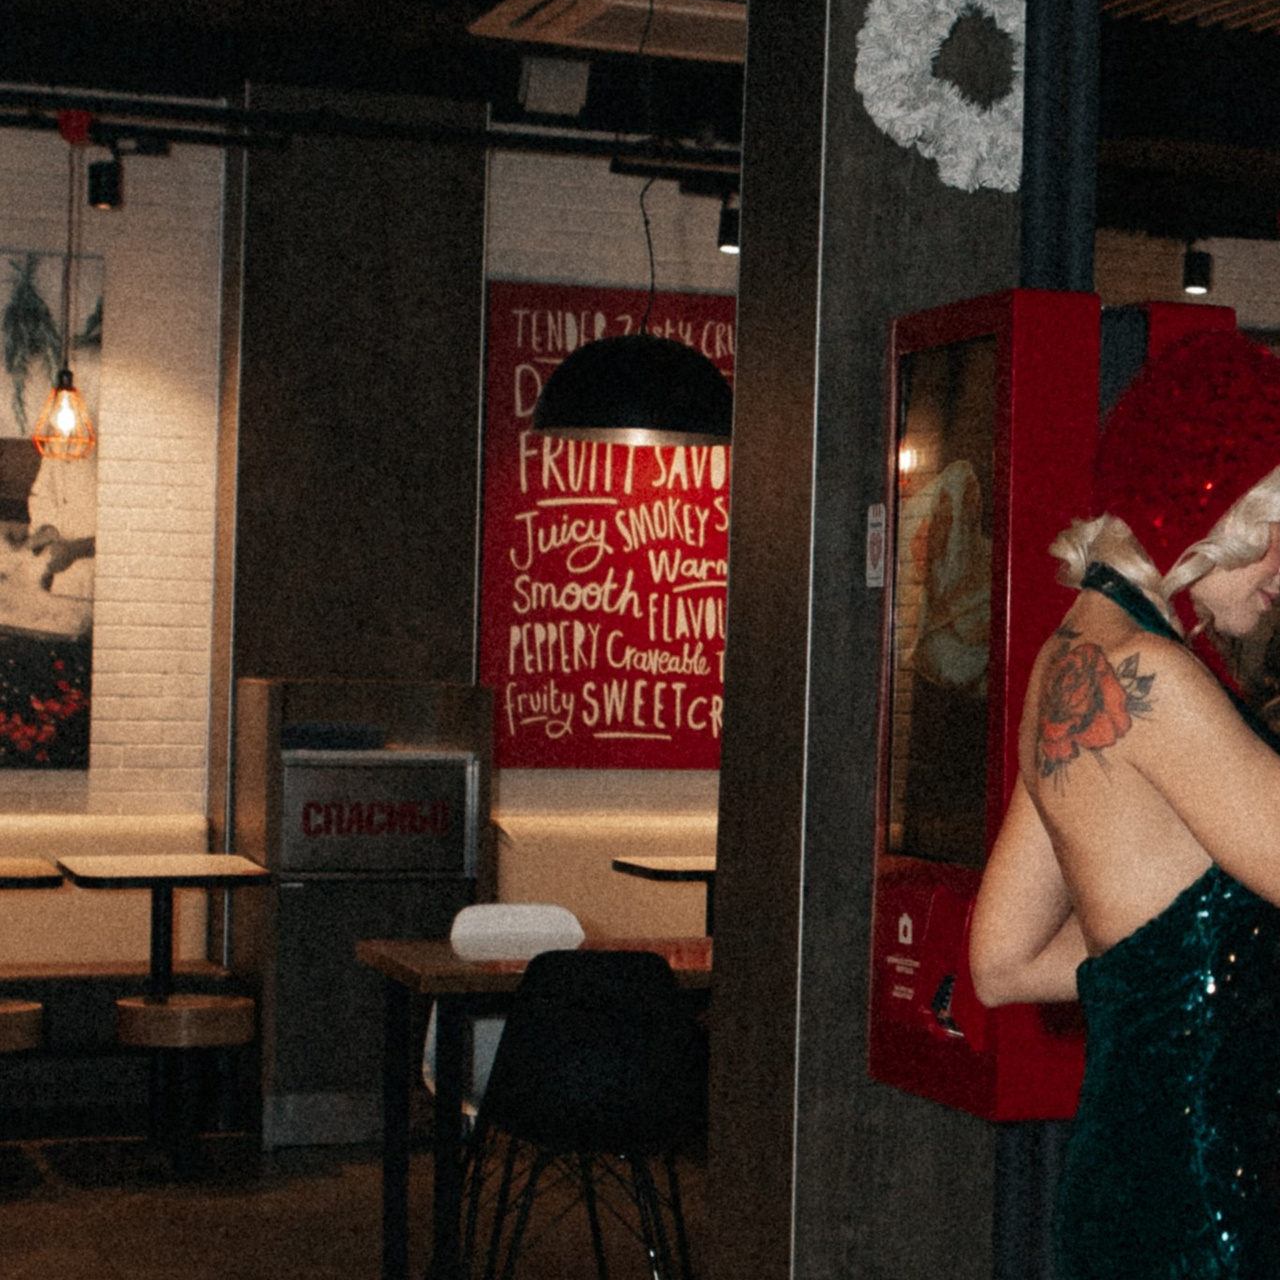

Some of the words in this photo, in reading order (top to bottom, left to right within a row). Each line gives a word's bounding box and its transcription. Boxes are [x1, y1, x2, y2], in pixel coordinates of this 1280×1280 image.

[512, 309, 607, 353] TENDER
[510, 511, 614, 573] Juicy
[615, 495, 710, 552] SMOKEY
[513, 567, 644, 619] Smooth
[509, 619, 601, 676] PEPPERY
[606, 629, 711, 676] Craveable
[504, 678, 575, 739] fruity
[582, 678, 688, 728] SWEET
[302, 799, 450, 837] СПАСИБО
